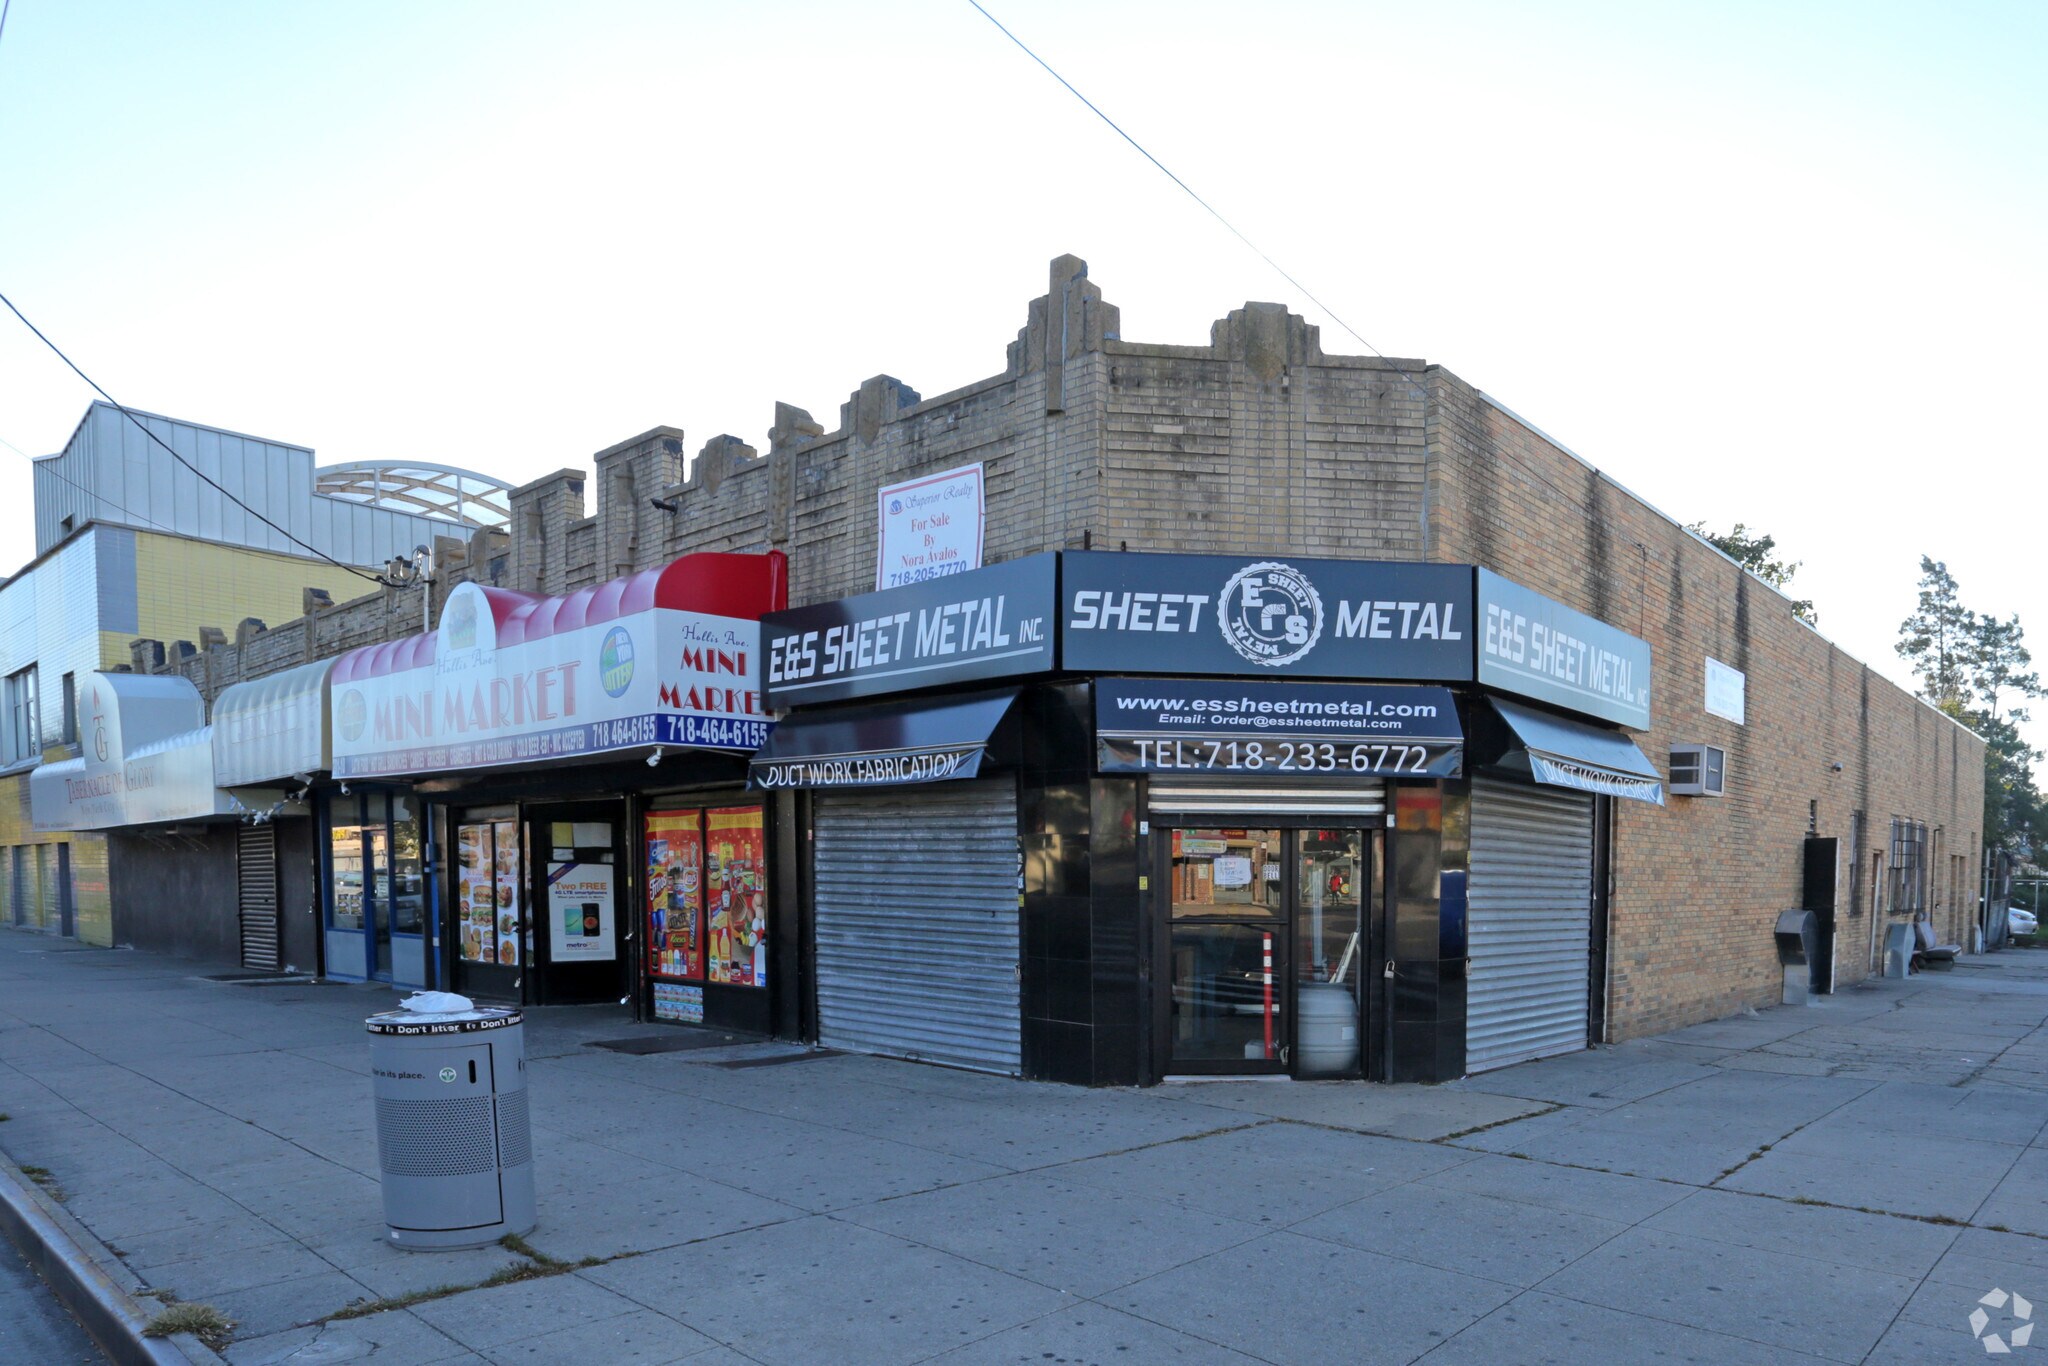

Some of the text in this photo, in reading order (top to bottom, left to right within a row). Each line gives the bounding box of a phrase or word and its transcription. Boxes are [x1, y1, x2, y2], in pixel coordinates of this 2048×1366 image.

[943, 482, 974, 500] Realty
[911, 512, 950, 532] For Sale
[924, 534, 935, 550] By
[901, 548, 958, 568] Nora Avalos
[1268, 574, 1312, 608] SHEET
[1070, 590, 1209, 632] SHEET
[1334, 600, 1462, 640] METAL
[681, 622, 750, 648] Hollis Ave.
[769, 631, 818, 683] E&S
[822, 612, 910, 674] SHEET
[914, 595, 1010, 658] METAL
[1232, 616, 1280, 656] METAL
[680, 644, 747, 676] MINI
[1485, 603, 1526, 664] E&S
[1530, 622, 1586, 686] SHEET
[1589, 646, 1634, 703] METAL
[373, 660, 581, 744] MINI MARKET
[657, 681, 773, 716] MARKE
[1116, 696, 1437, 718] www.essheetmetal.com
[592, 714, 656, 748] 718 464-6155
[668, 716, 768, 746] 718-464-6155
[1158, 713, 1402, 730] Email: Order@essheetmetal.com
[766, 752, 960, 787] DUCT WORK FABRICATION
[1542, 760, 1656, 800] DUCT WORK DESIGN
[555, 882, 608, 890] Two FREE
[398, 1025, 427, 1034] Don't
[480, 1018, 506, 1030] Don't
[386, 1069, 397, 1078] its
[398, 1072, 426, 1080] place.
